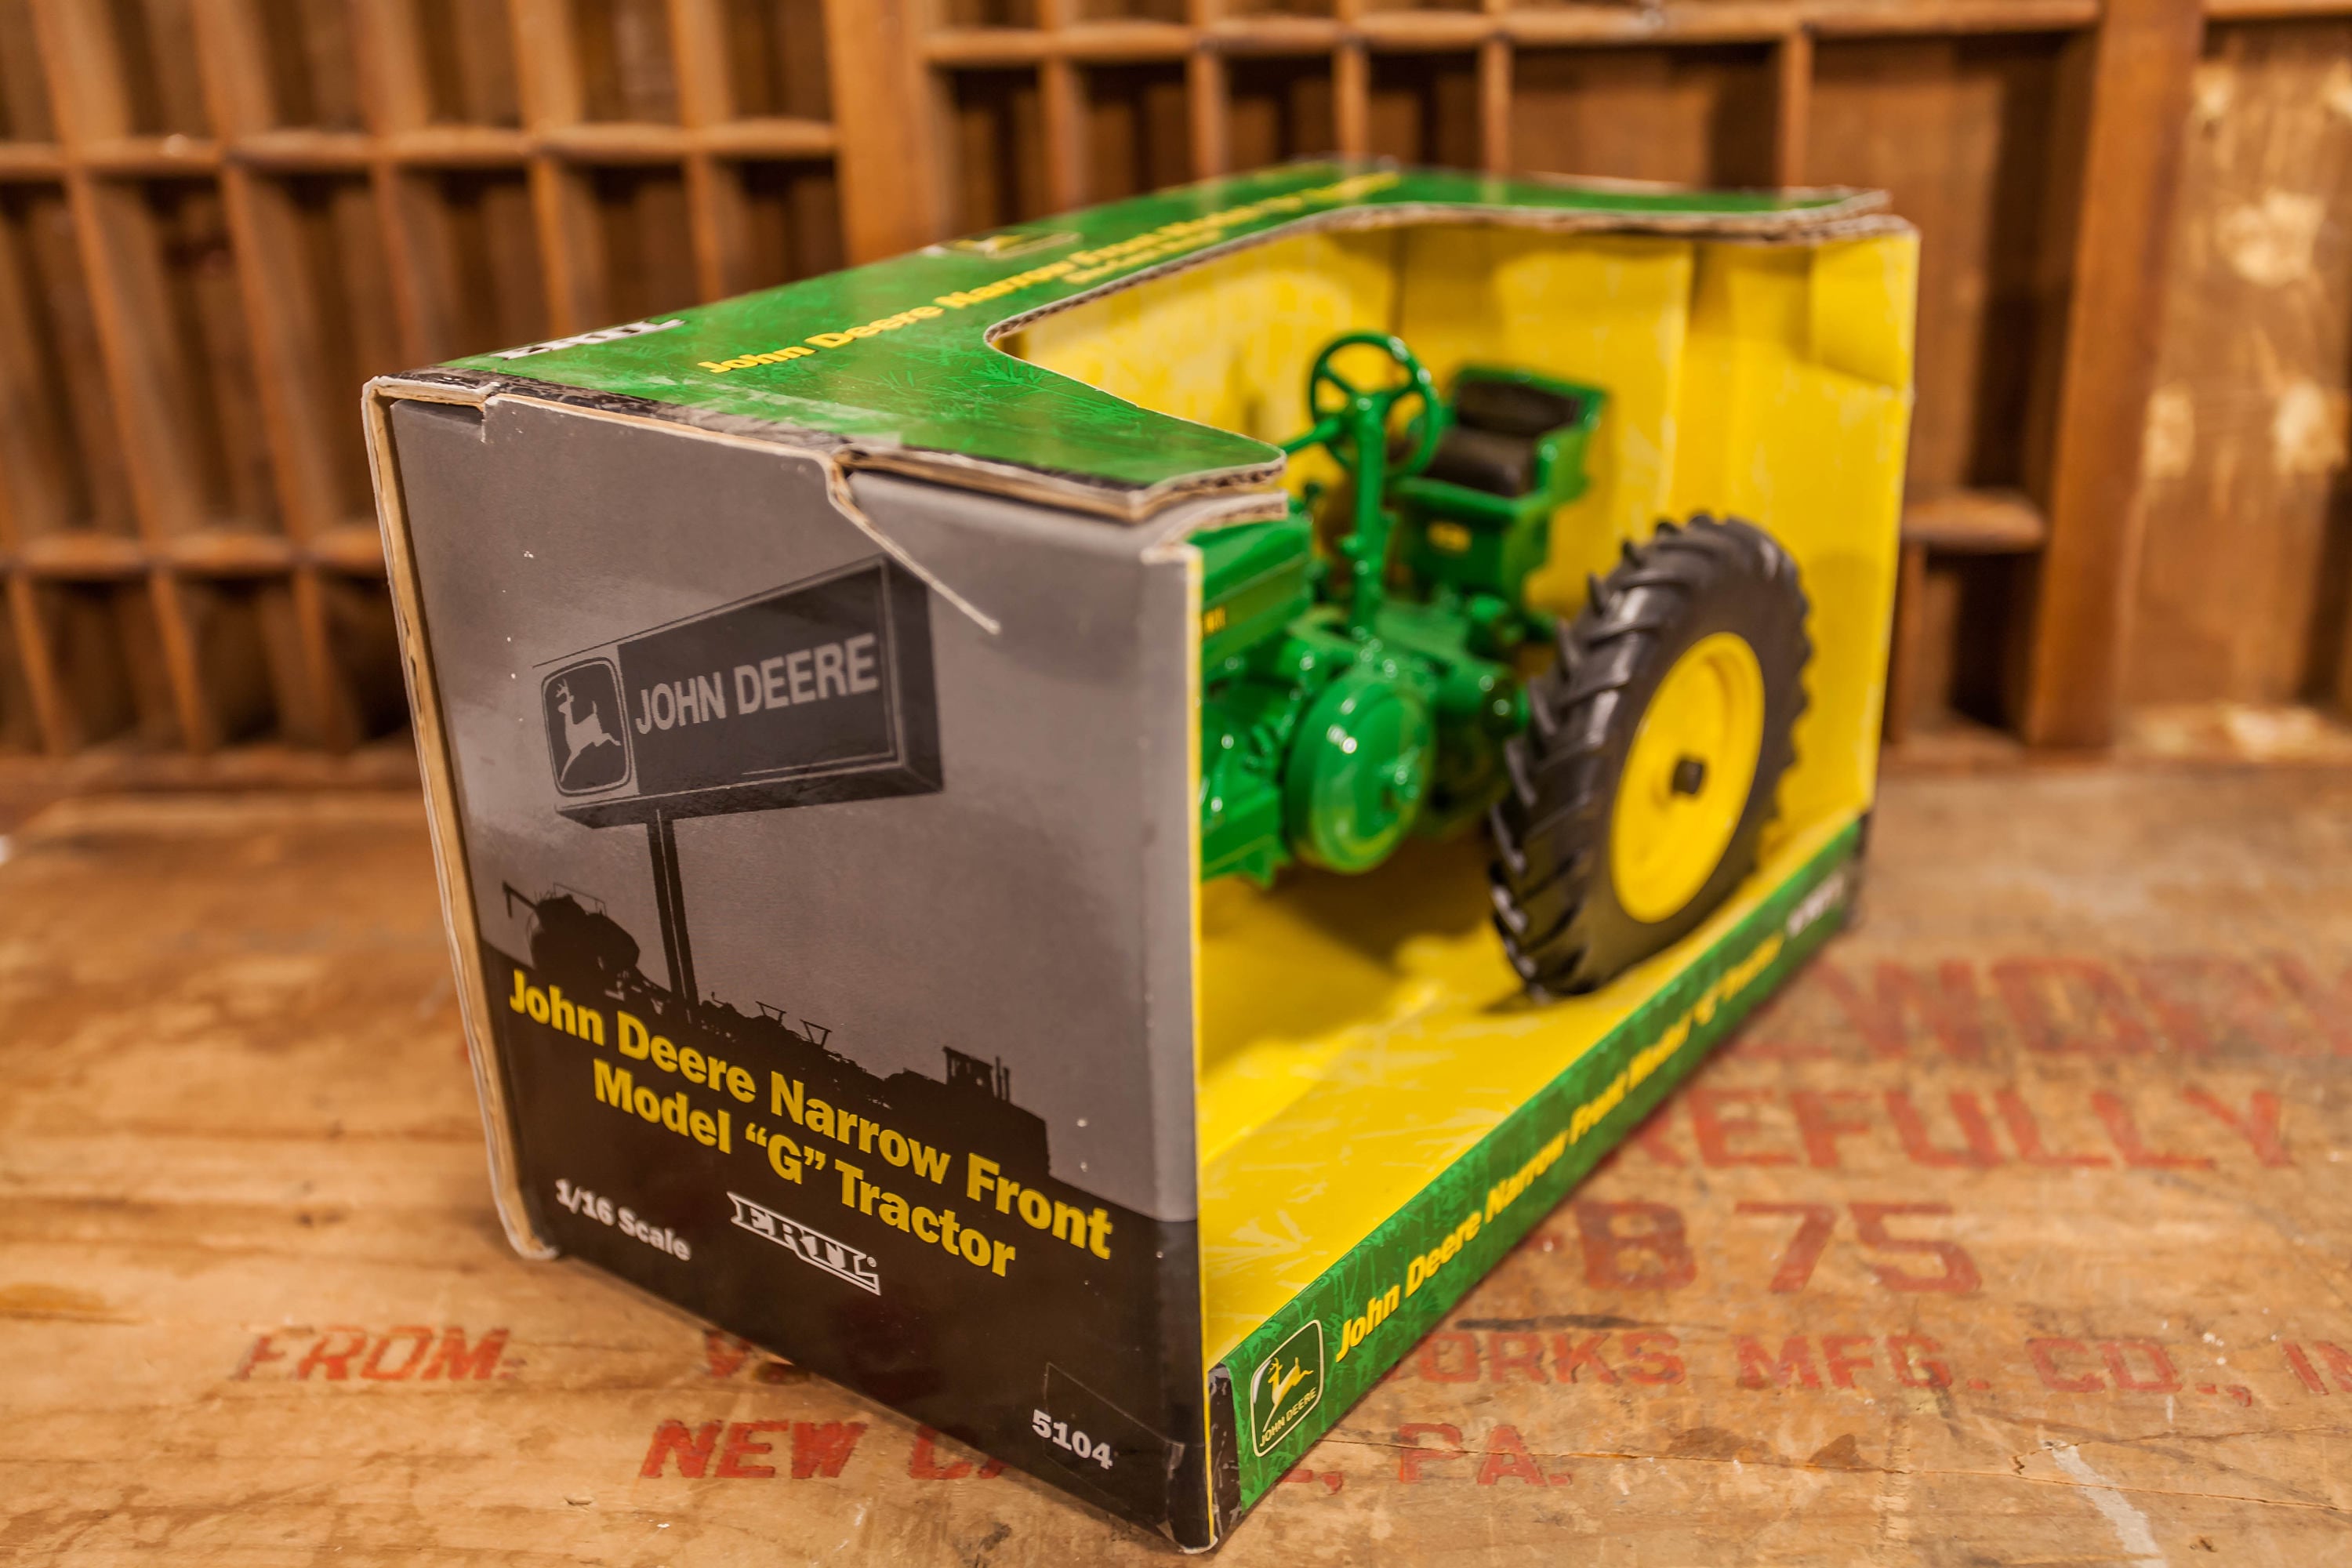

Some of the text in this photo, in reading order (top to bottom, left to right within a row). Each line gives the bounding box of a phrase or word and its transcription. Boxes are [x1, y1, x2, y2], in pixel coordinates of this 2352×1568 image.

[698, 345, 818, 373] John
[805, 306, 944, 348] Deere
[635, 633, 880, 735] JOHN DEERE
[510, 968, 1113, 1261] John Deere Narrow Front
[593, 1058, 732, 1155] Model
[834, 1159, 1016, 1278] Tractor
[555, 1178, 691, 1261] 1/16 Scale
[1734, 1201, 1983, 1294] 75
[1336, 1283, 1400, 1363] John
[1406, 1210, 1483, 1298] Deere
[1399, 1331, 1687, 1385] ORKS
[641, 1418, 868, 1480] NEW
[1032, 1408, 1113, 1470] 5104
[1260, 1387, 1317, 1447] JOHN DEERE
